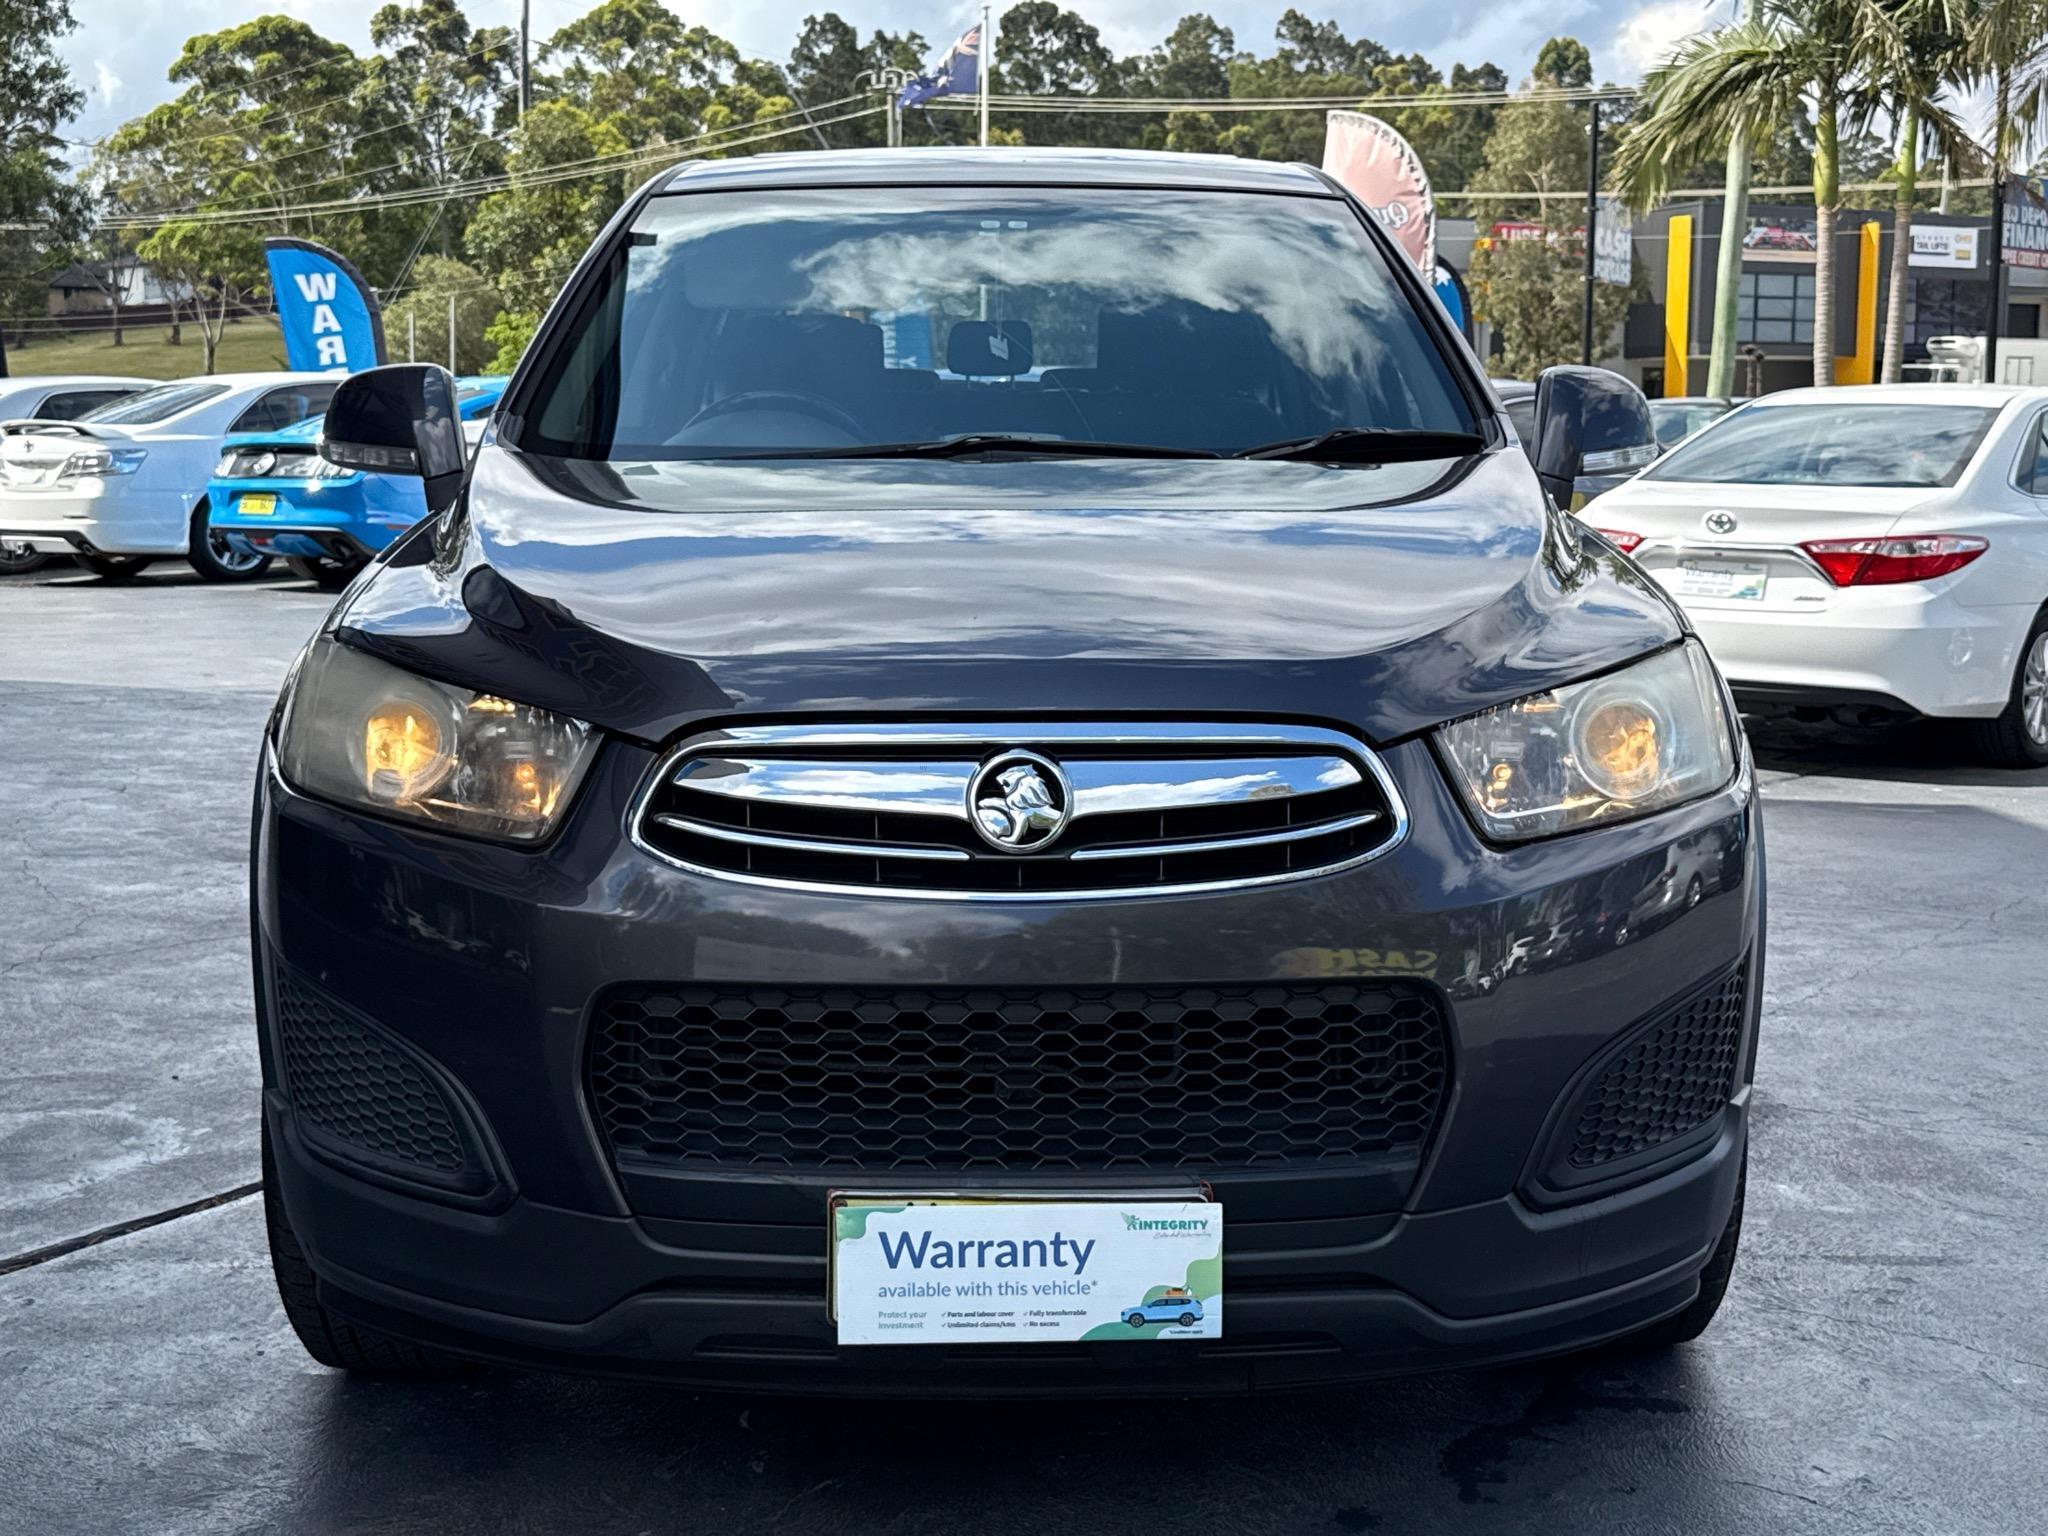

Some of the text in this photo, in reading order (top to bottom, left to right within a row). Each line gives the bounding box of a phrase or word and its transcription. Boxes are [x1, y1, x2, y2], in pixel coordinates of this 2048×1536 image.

[1138, 1220, 1209, 1231] INTEGRITY
[878, 1230, 1097, 1275] Warranty
[878, 1281, 951, 1297] available
[955, 1280, 993, 1297] with
[997, 1280, 1028, 1296] this
[878, 1311, 927, 1320] Protect your
[1029, 1310, 1045, 1318] Fully
